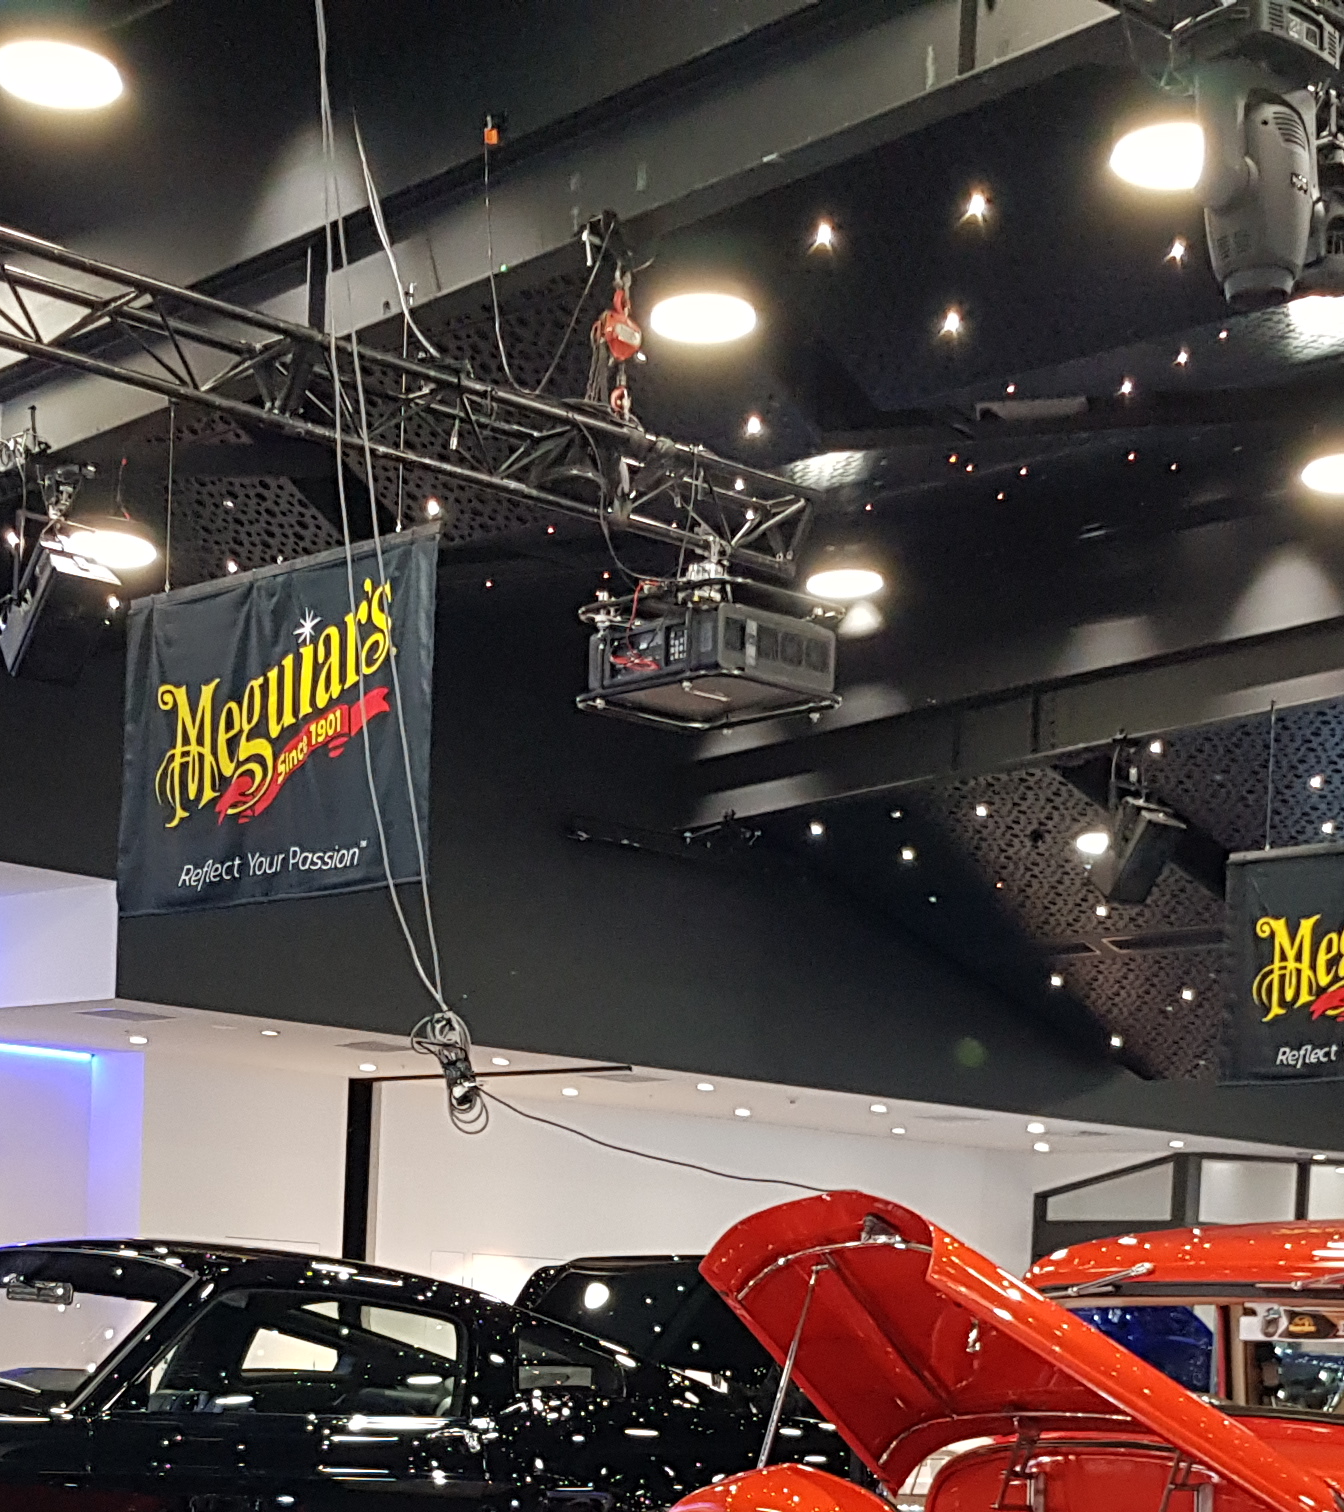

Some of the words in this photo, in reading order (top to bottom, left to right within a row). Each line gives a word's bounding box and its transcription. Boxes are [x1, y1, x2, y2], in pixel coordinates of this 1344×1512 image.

[156, 578, 397, 829] Meguiar's
[277, 735, 308, 784] Since
[309, 709, 342, 746] 1901
[178, 858, 241, 892] Reflect
[247, 851, 286, 878] Your
[1276, 1044, 1338, 1069] Reflect
